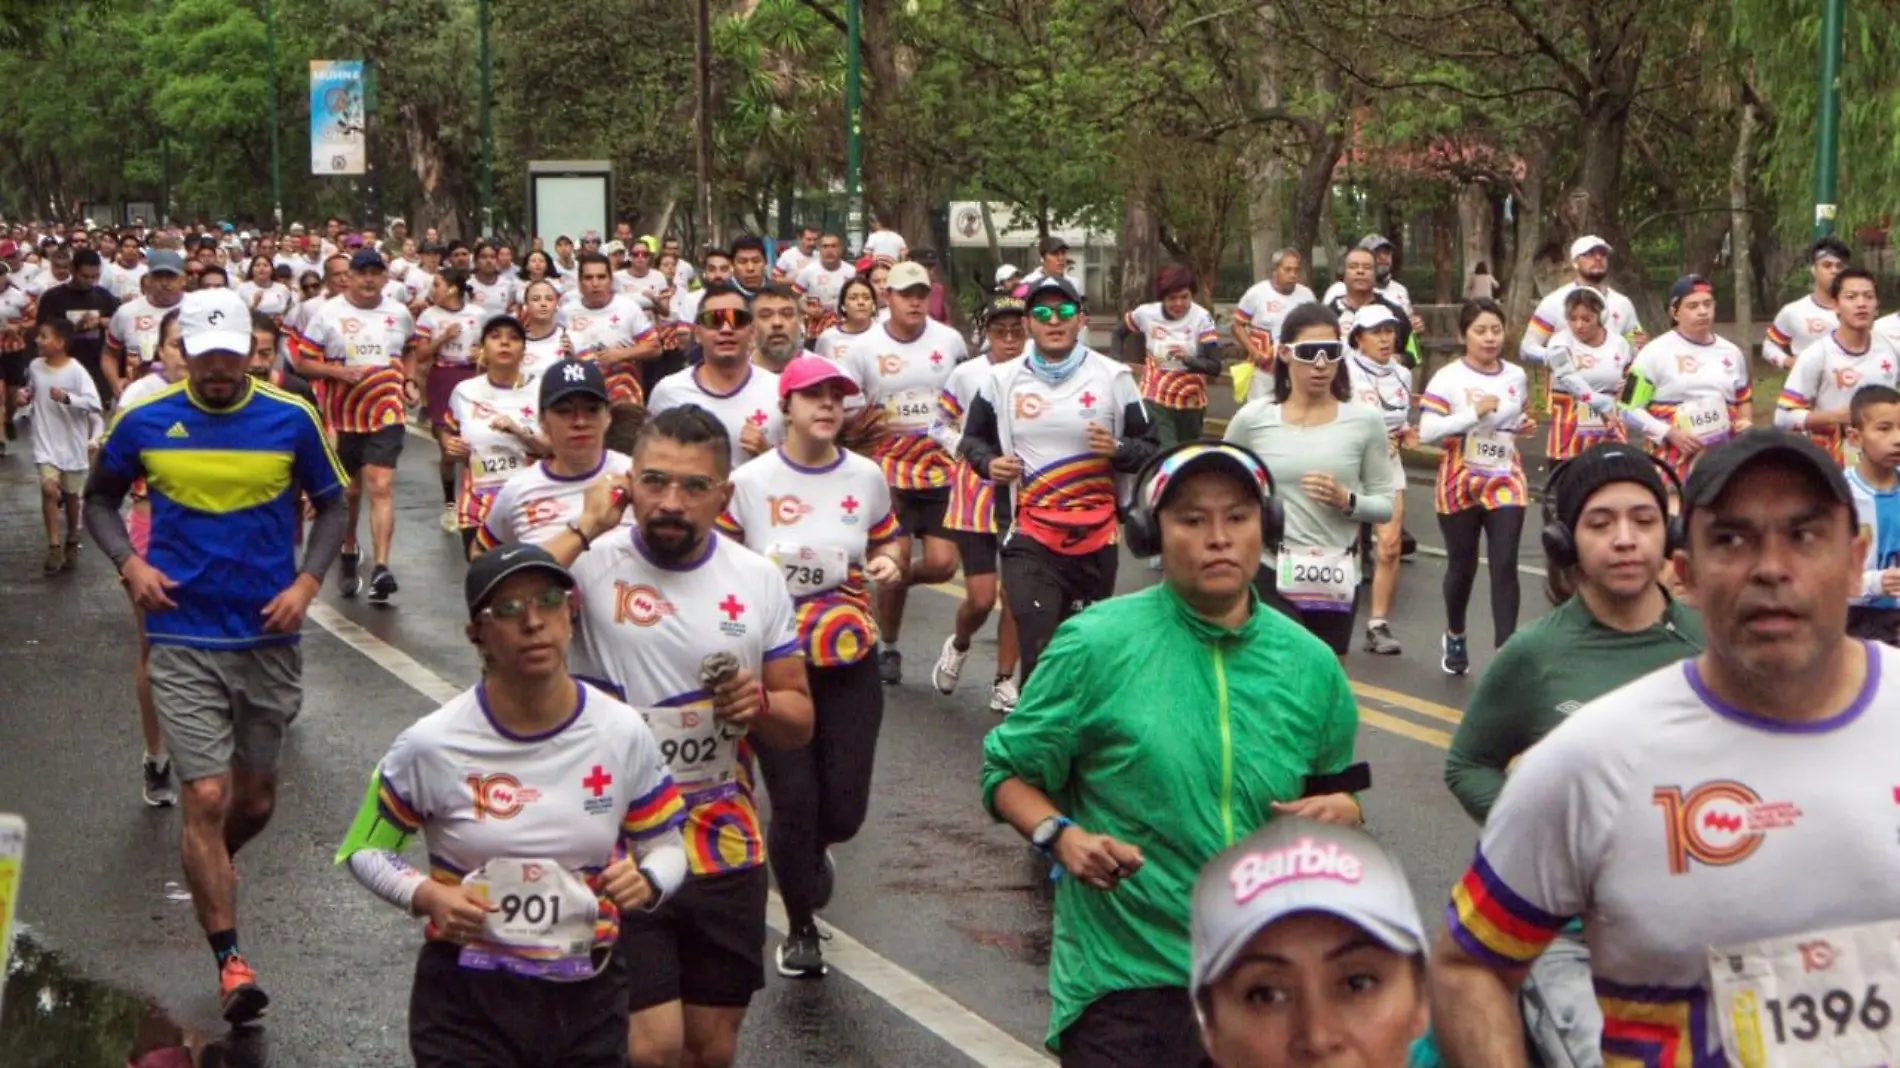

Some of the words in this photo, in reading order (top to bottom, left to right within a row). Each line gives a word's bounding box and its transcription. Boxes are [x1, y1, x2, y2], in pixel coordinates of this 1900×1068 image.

[481, 456, 517, 472] 1228
[785, 564, 824, 585] 738
[1294, 564, 1344, 584] 2000
[661, 737, 717, 765] 902
[1651, 779, 1766, 875] 10
[1230, 837, 1363, 904] Barbie
[501, 894, 560, 925] 901
[1765, 983, 1892, 1044] 1396
